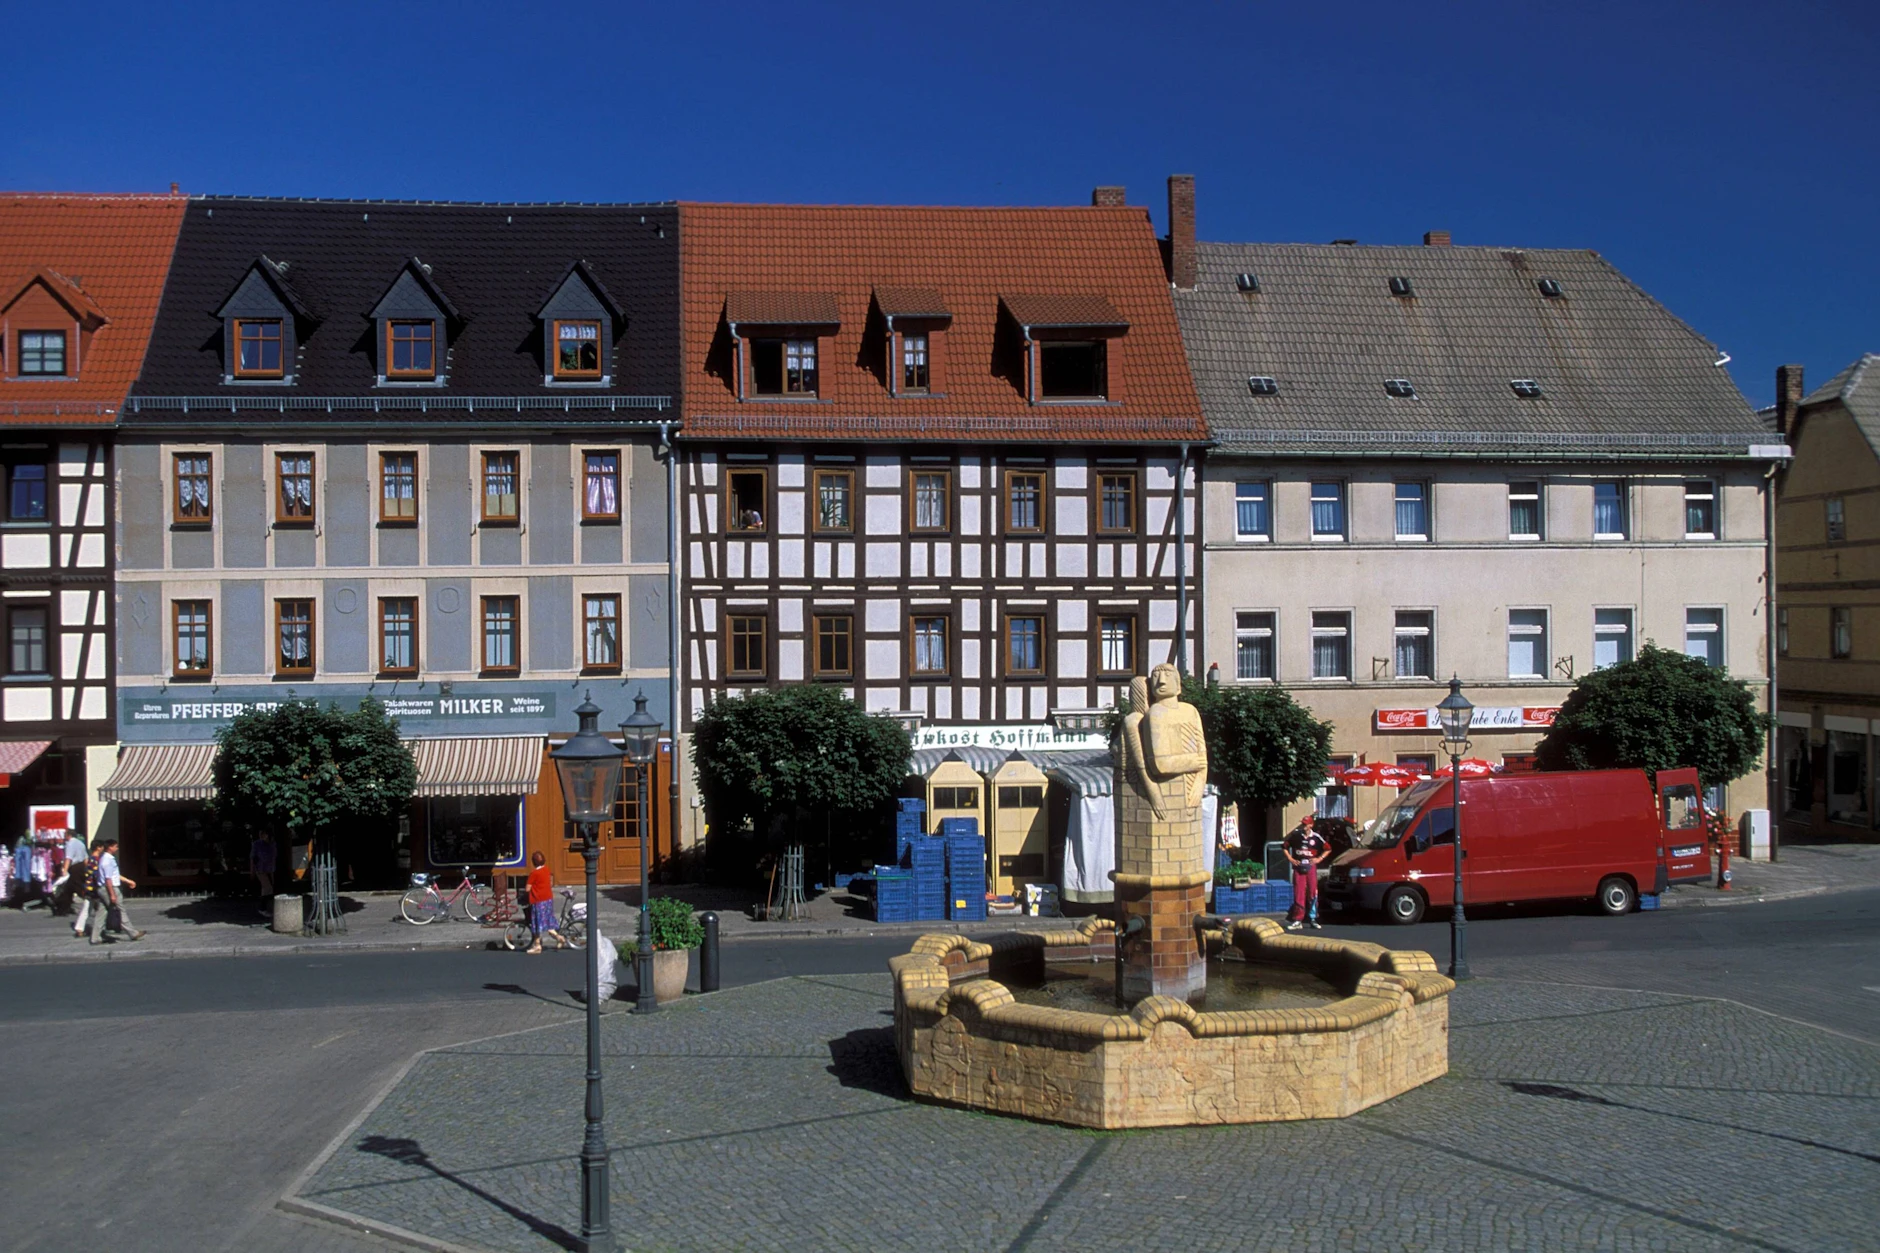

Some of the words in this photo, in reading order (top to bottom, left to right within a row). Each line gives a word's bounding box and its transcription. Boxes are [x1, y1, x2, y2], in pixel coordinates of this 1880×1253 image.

[385, 708, 432, 717] Spirituosen
[440, 699, 504, 714] MILKER
[1493, 709, 1519, 725] Enke
